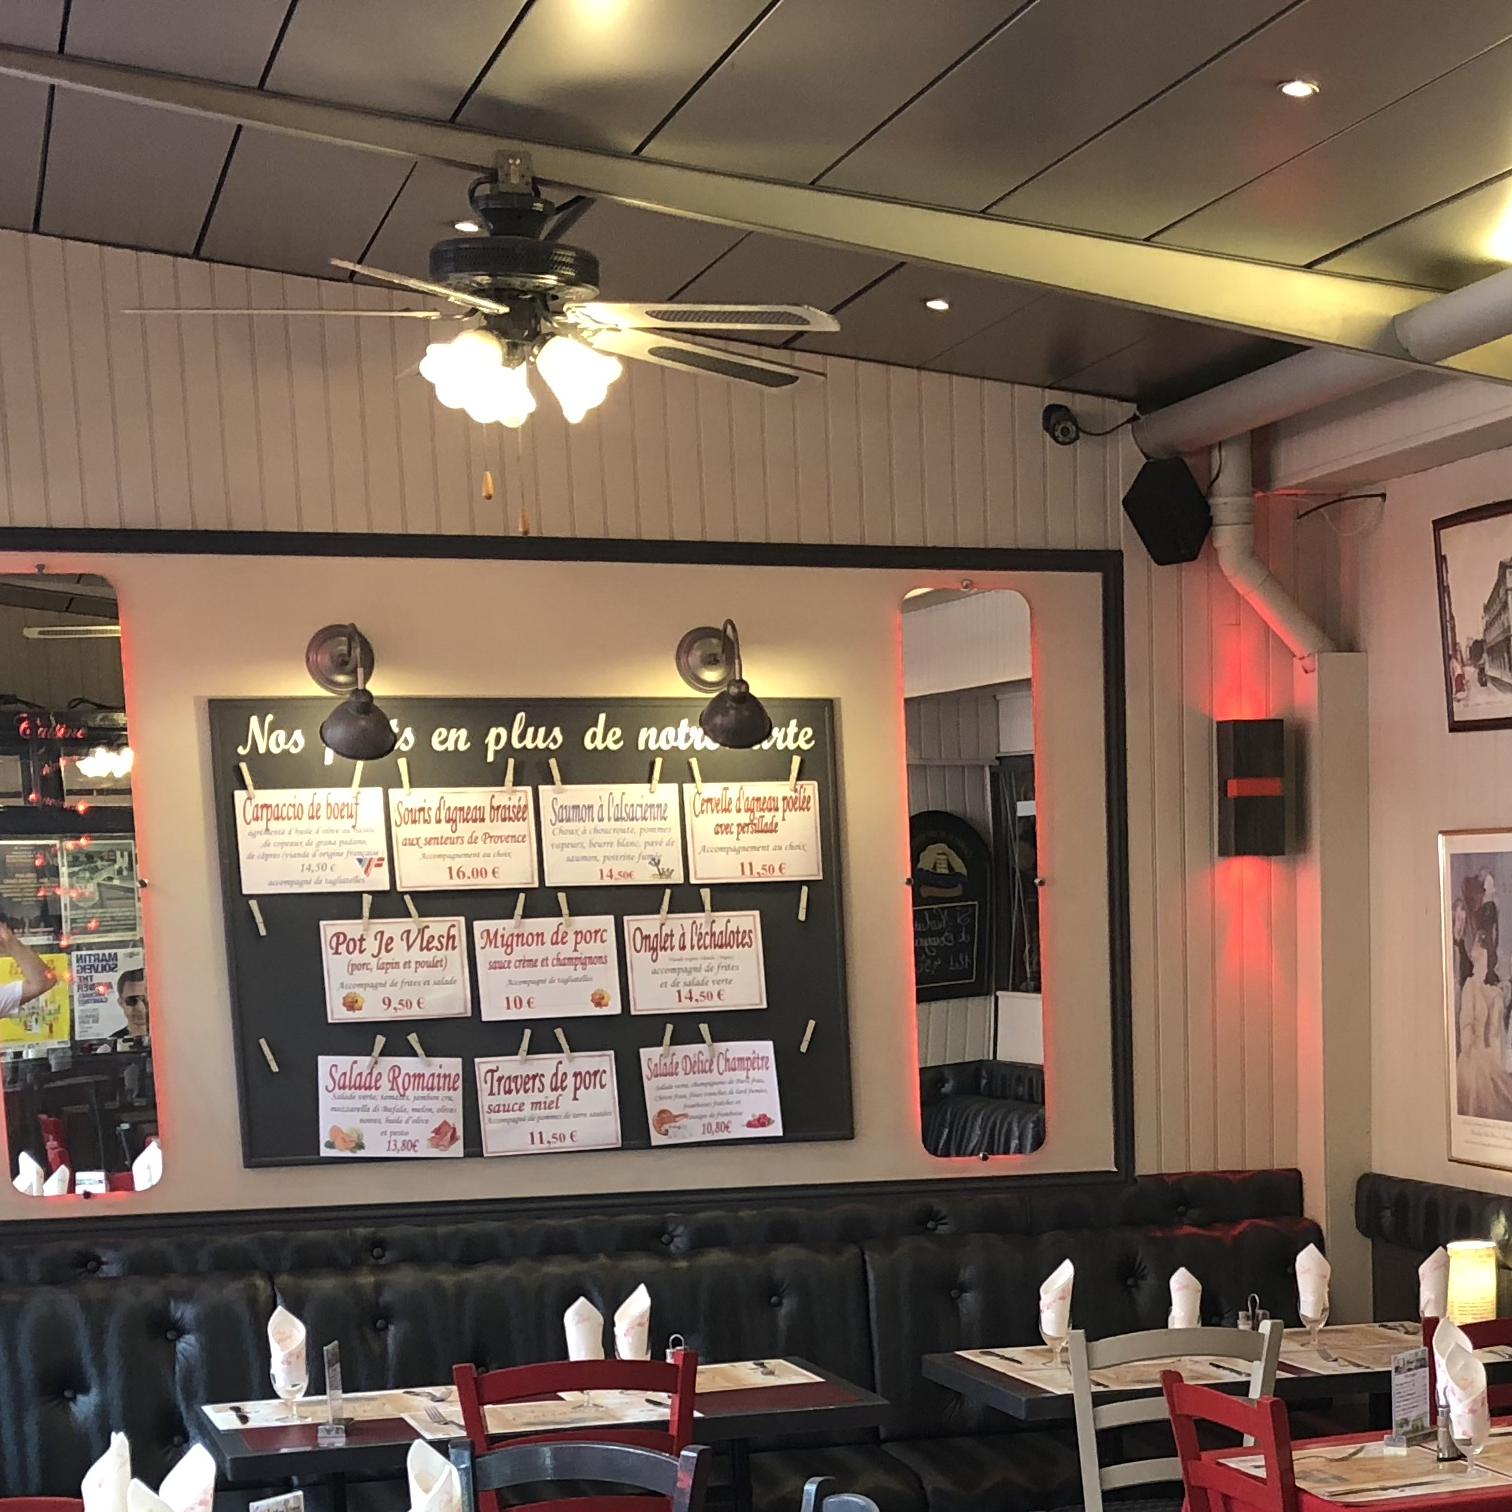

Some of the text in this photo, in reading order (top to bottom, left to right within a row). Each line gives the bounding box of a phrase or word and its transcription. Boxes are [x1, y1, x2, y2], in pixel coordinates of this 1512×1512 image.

[237, 713, 305, 755] Nos
[431, 726, 470, 752] en
[485, 711, 563, 763] plus
[583, 712, 623, 750] de
[243, 791, 361, 831] Carpaccio de boeuf
[394, 794, 528, 833] Souris d'agneau braisée
[550, 792, 668, 826] Saumon à l'alsacienne
[693, 786, 812, 821] Cervelle d'agneau poêlée
[401, 831, 527, 848] aux senteurs de Provence
[713, 815, 778, 841] avec persillade
[491, 866, 500, 879] €
[778, 862, 788, 876] €
[329, 923, 457, 958] Pot Je Vlesh
[480, 922, 607, 955] Mignon de porc
[633, 918, 753, 963] Onglet à l'échalotes
[376, 957, 400, 974] lapin
[402, 958, 412, 970] et
[415, 955, 448, 974] poulet)
[488, 952, 608, 971] sauce crème et champignons
[382, 996, 425, 1012] 9,50 €
[505, 995, 536, 1011] 10 €
[716, 988, 726, 1001] €
[646, 1048, 770, 1081] Salade Délice Champêtre
[325, 1060, 460, 1097] Salade Romaine
[484, 1061, 607, 1100] Travers de porc
[486, 1095, 560, 1114] sauce miel
[386, 1139, 419, 1153] 13,80€
[570, 1130, 577, 1143] €
